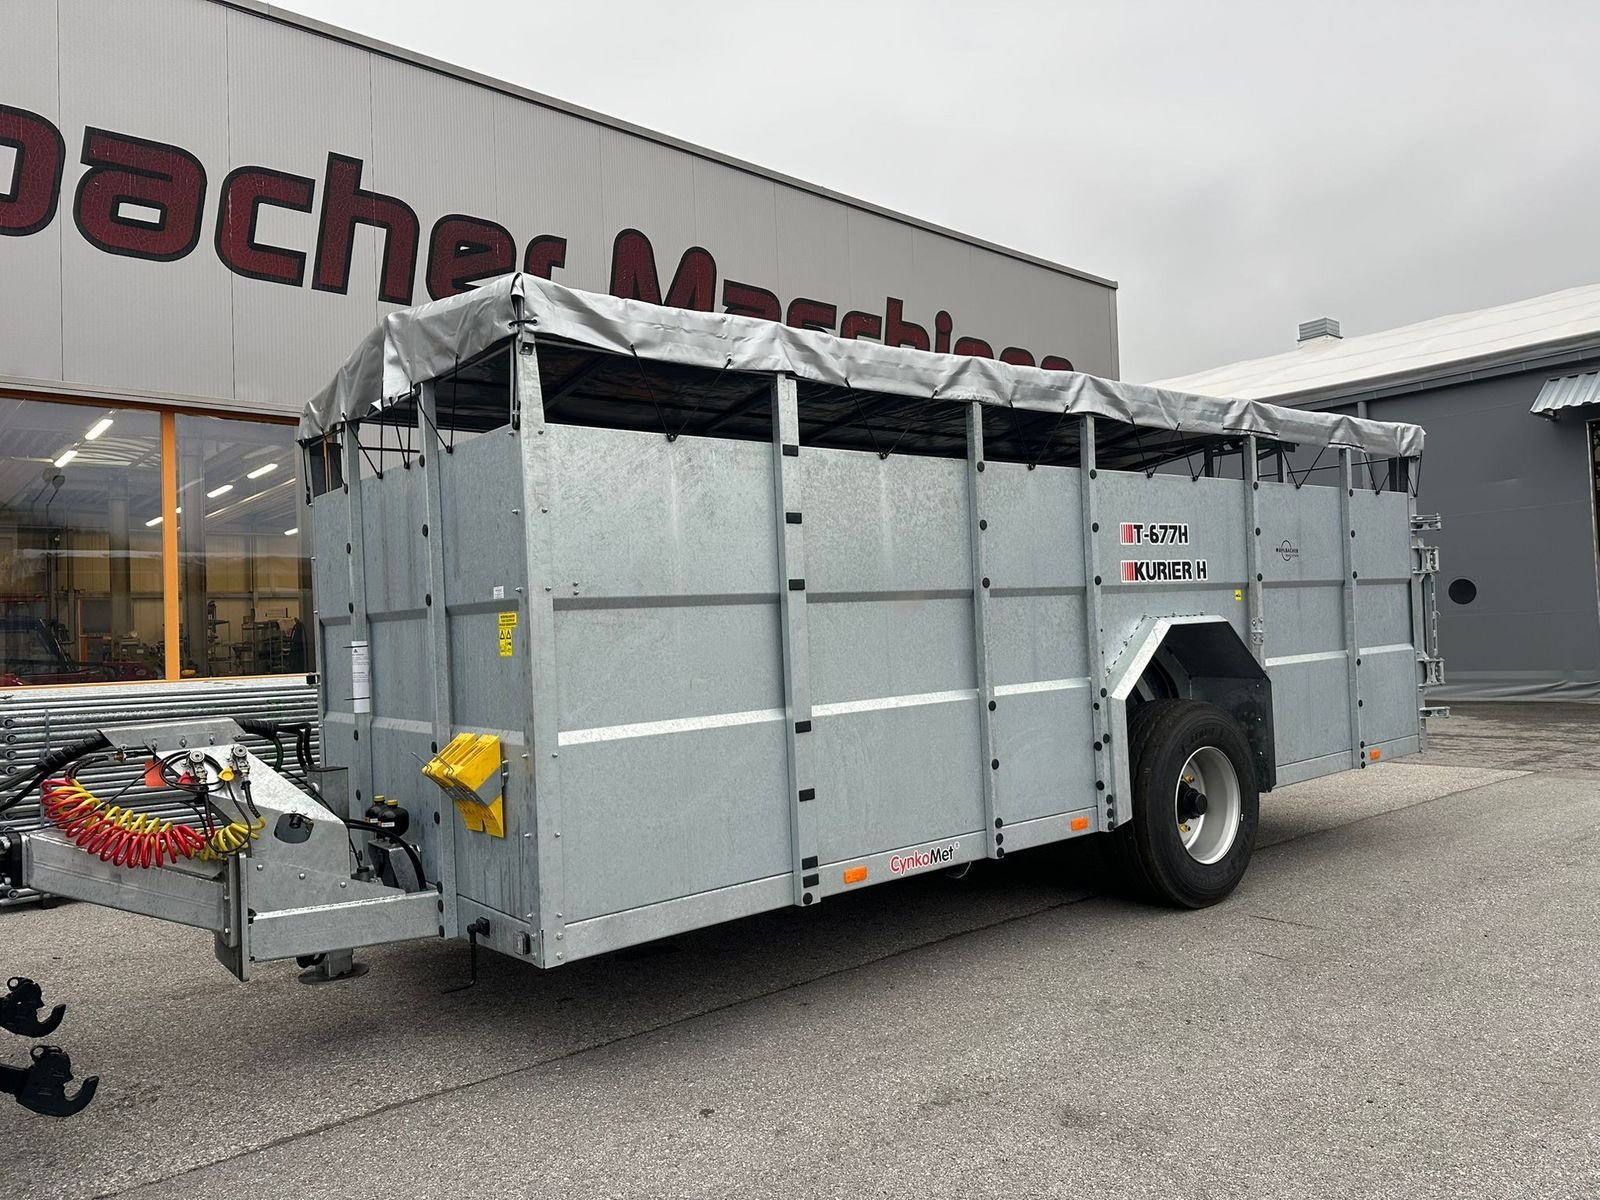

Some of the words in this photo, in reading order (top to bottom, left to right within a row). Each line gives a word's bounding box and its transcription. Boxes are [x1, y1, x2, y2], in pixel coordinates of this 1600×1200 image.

[1133, 523, 1189, 545] T-677H
[1133, 560, 1193, 581] KURIER
[1196, 560, 1207, 580] H
[890, 845, 954, 875] CynkoMet
